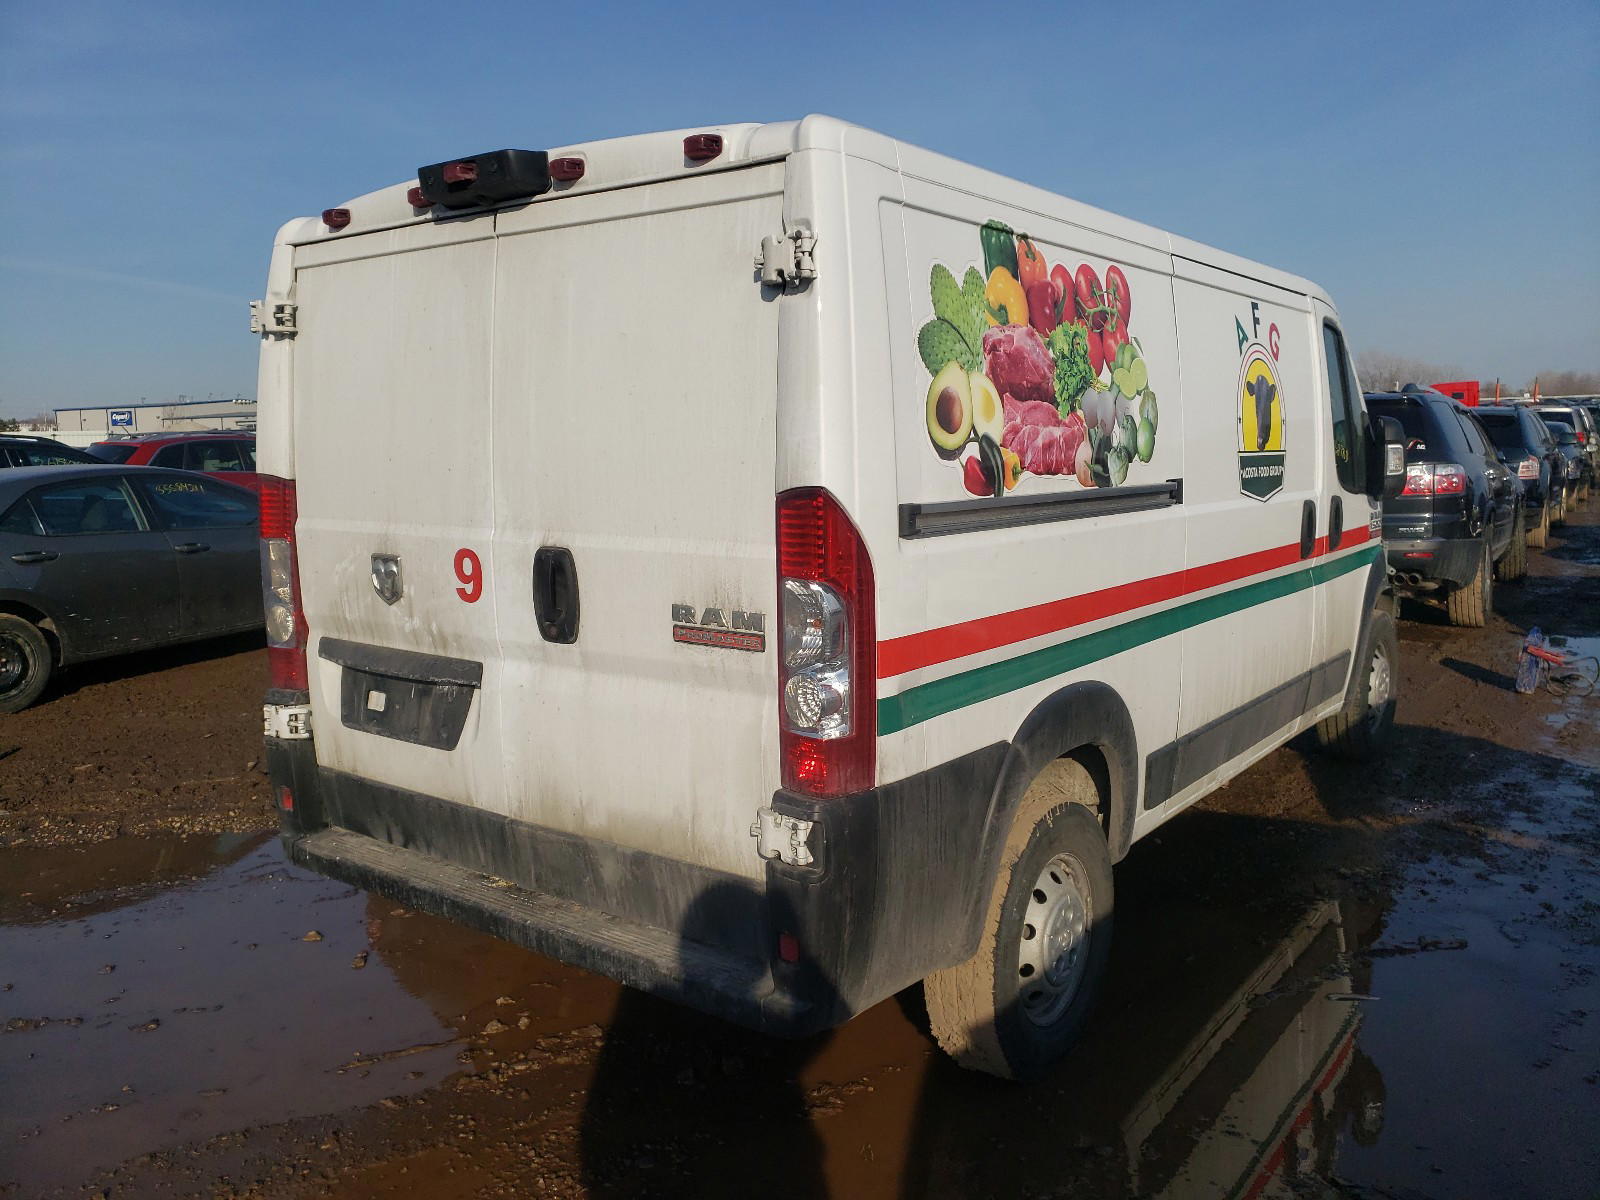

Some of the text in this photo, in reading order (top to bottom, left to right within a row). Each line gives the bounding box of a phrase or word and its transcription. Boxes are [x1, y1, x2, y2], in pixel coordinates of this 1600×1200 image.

[1258, 466, 1269, 477] FOOD
[1270, 466, 1282, 476] GROUP
[453, 547, 483, 604] 9
[671, 603, 767, 632] RAM
